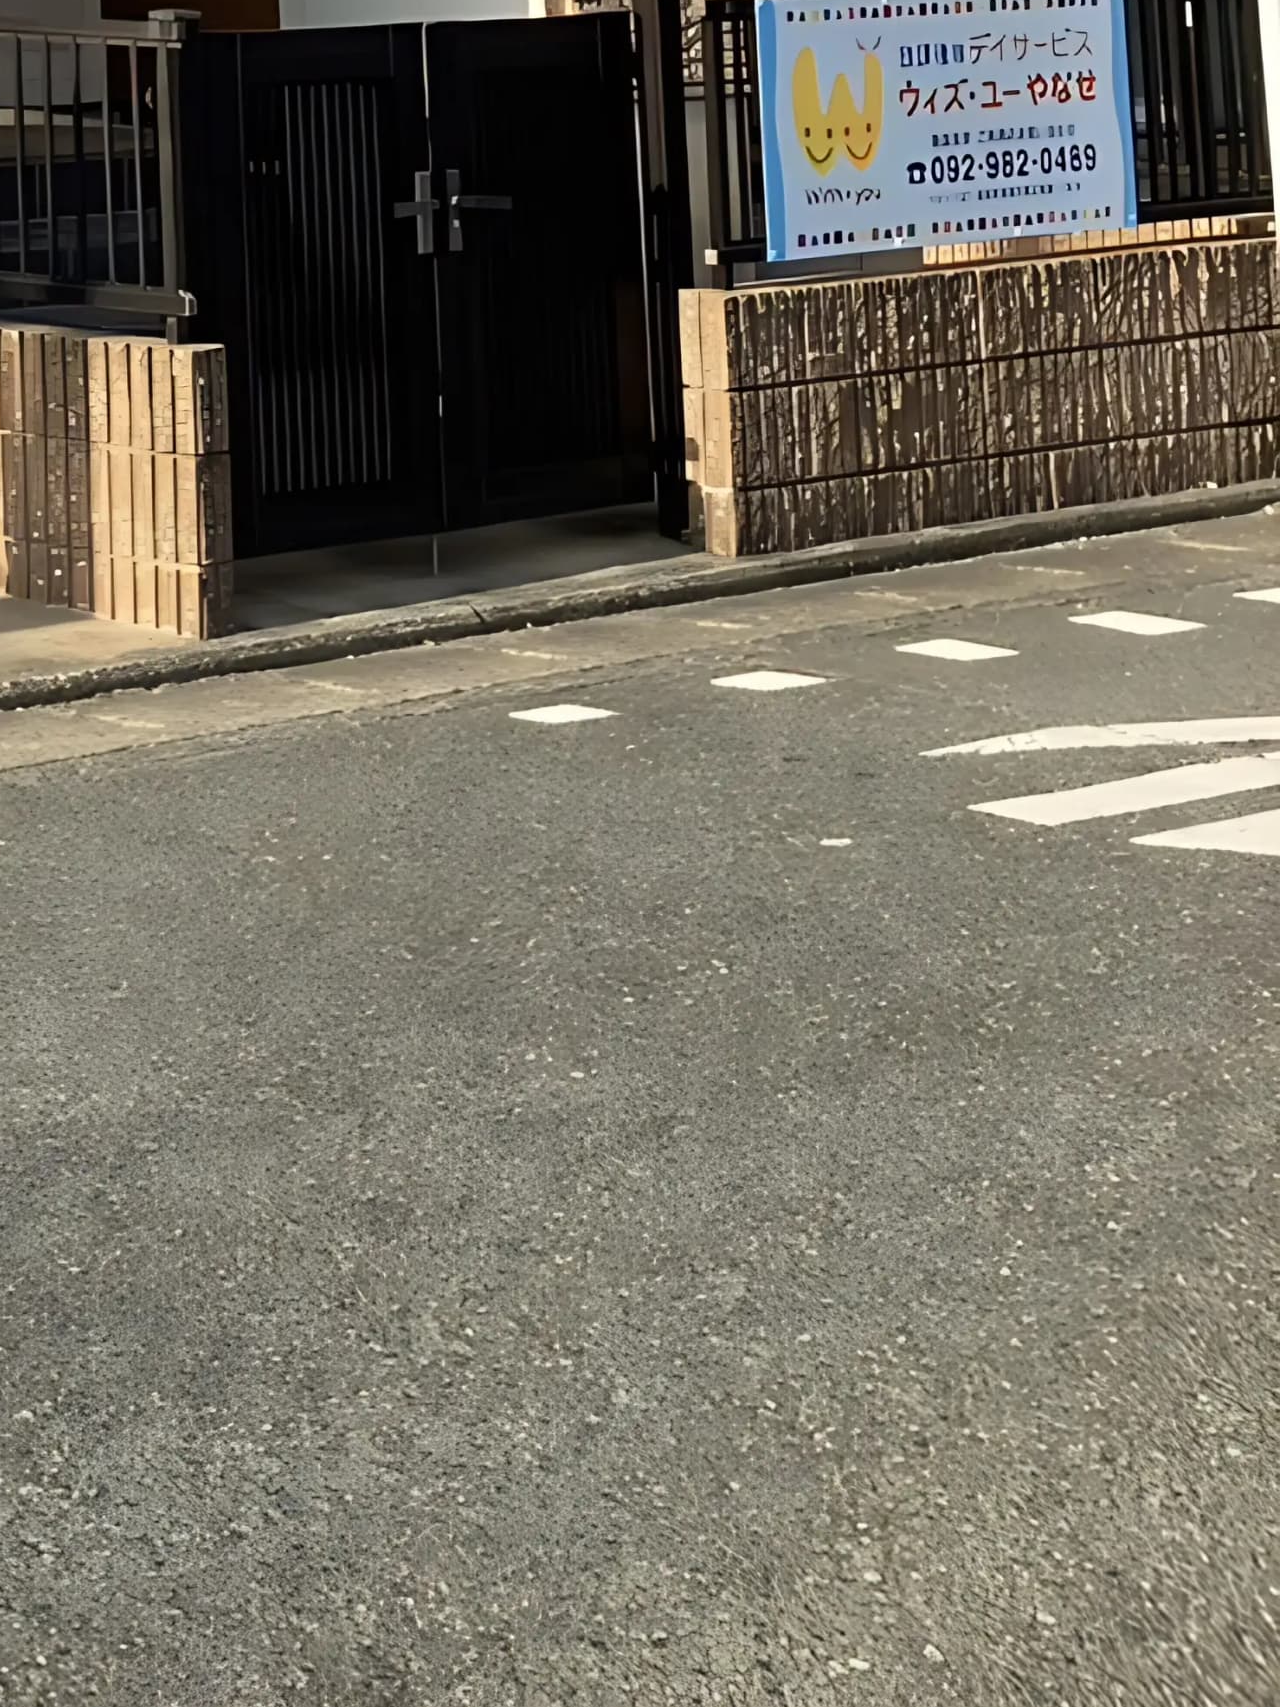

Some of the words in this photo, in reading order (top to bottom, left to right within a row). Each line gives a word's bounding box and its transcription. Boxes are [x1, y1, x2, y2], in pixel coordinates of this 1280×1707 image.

[899, 27, 1093, 68] デイサービス
